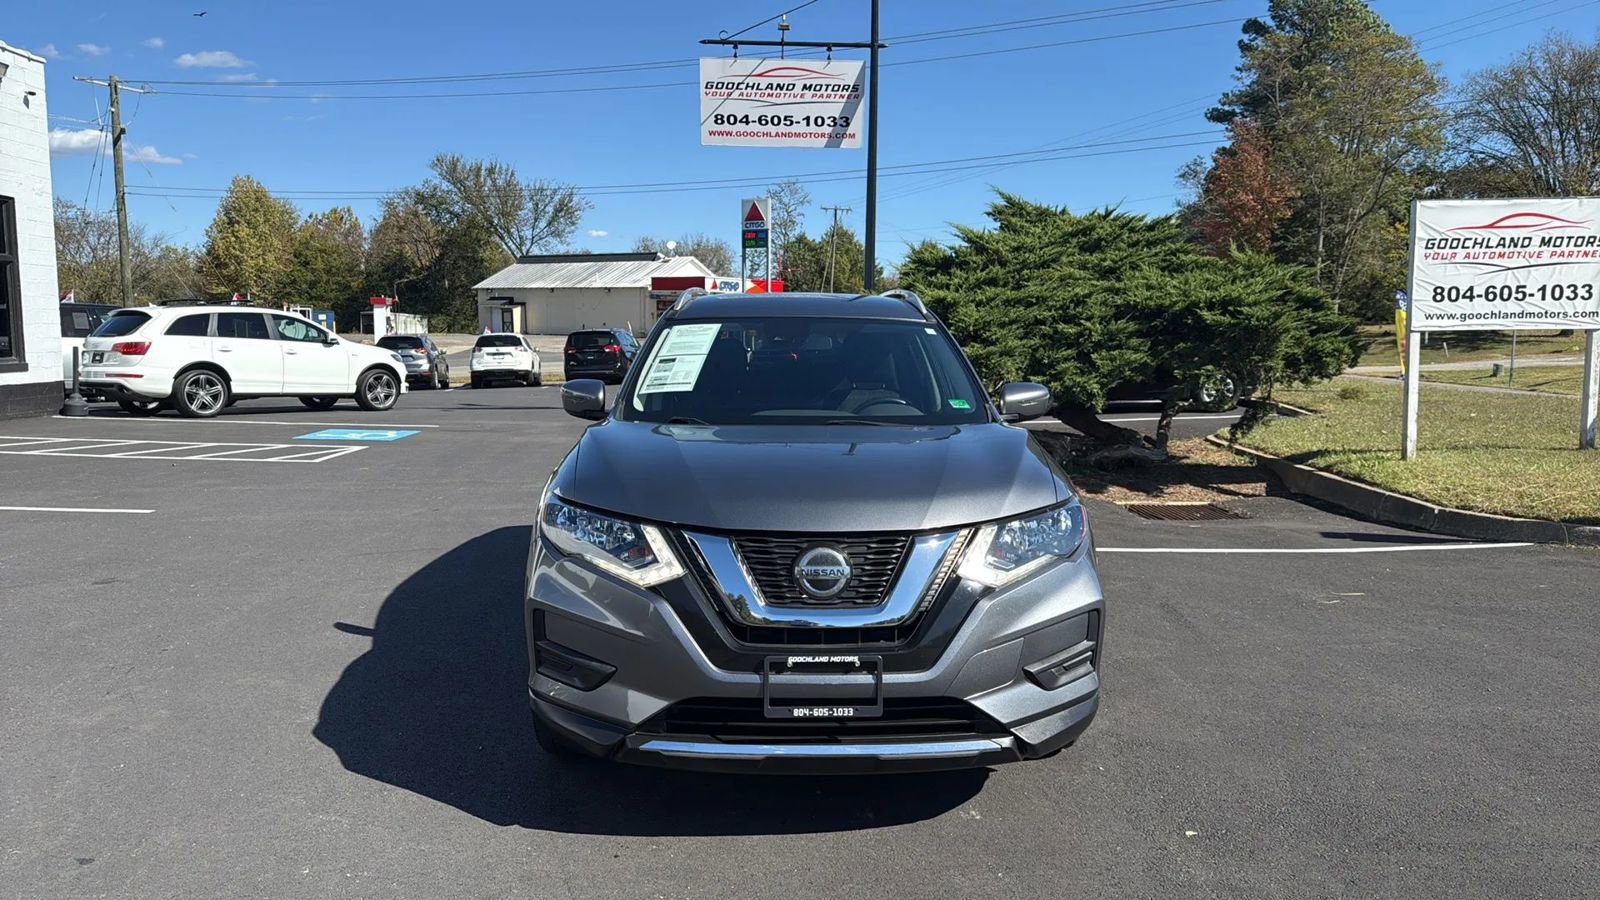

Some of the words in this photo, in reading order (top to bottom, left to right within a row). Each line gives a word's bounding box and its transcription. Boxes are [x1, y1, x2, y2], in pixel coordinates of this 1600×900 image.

[705, 82, 796, 91] GOOCHLAND
[801, 83, 860, 93] MOTORS
[738, 91, 806, 99] AUTOMOTIVE
[714, 114, 850, 127] 804-605-1033
[708, 130, 856, 139] WWW.GOOCHLANDMOTORS.COM
[1424, 236, 1533, 250] GOOCHLAND
[1424, 251, 1457, 261] YOUR
[1463, 250, 1544, 260] AUTOMOTIVE
[1549, 249, 1600, 259] PARTNE
[1432, 284, 1594, 303] 804-605-1033
[1424, 309, 1600, 322] www.goochlandmotors.com
[802, 568, 845, 577] NISSAN
[793, 708, 853, 717] 804-605-1033
